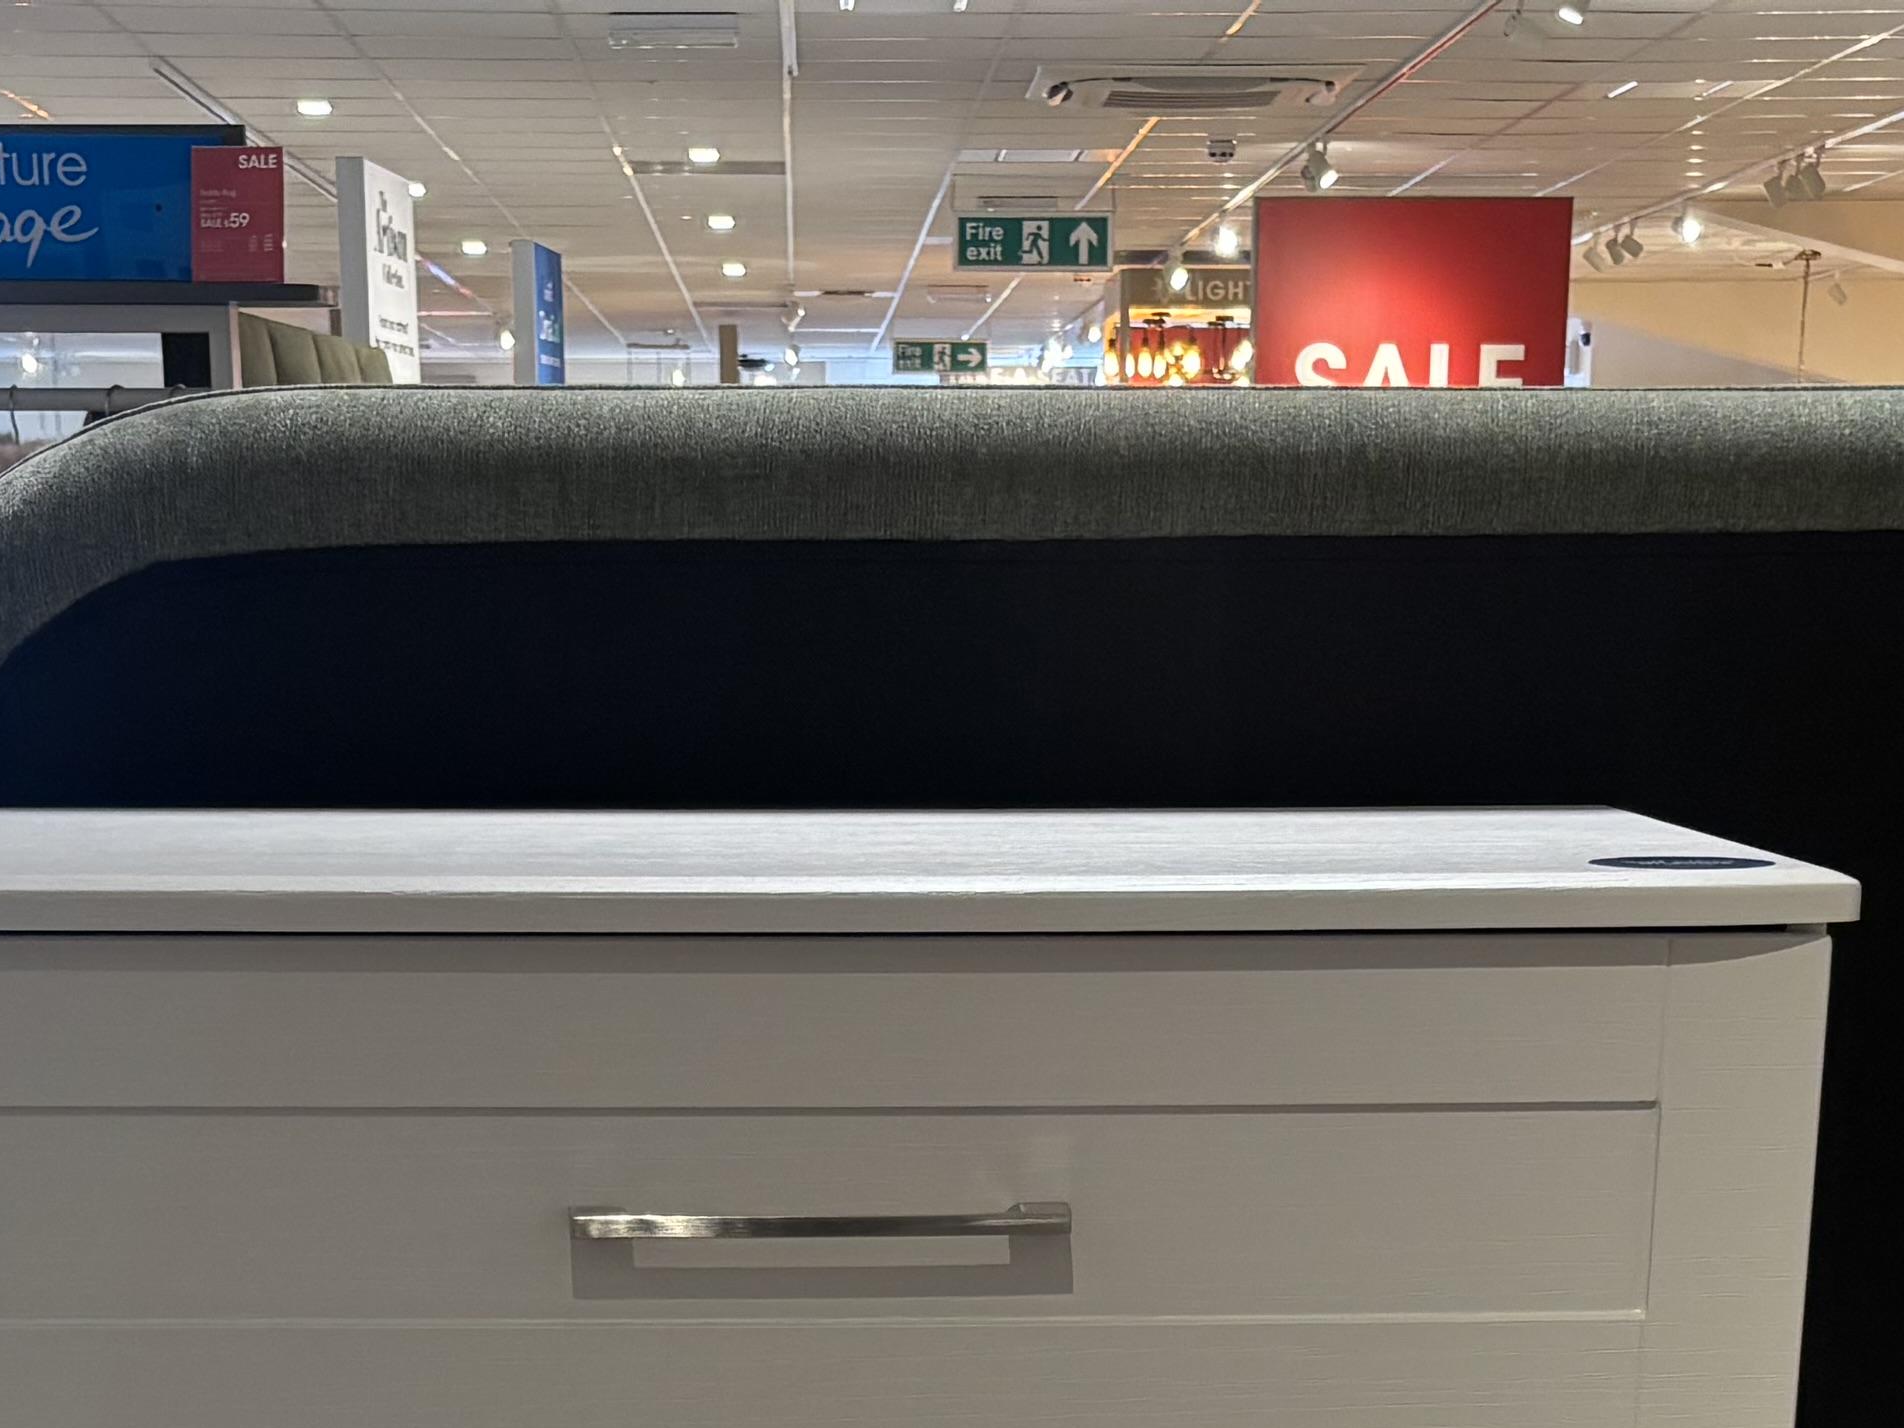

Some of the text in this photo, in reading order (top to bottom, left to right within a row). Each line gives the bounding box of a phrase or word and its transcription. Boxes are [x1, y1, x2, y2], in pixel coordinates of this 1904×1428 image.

[238, 153, 278, 170] SALE
[965, 222, 1004, 241] Fire
[966, 243, 1003, 261] exit
